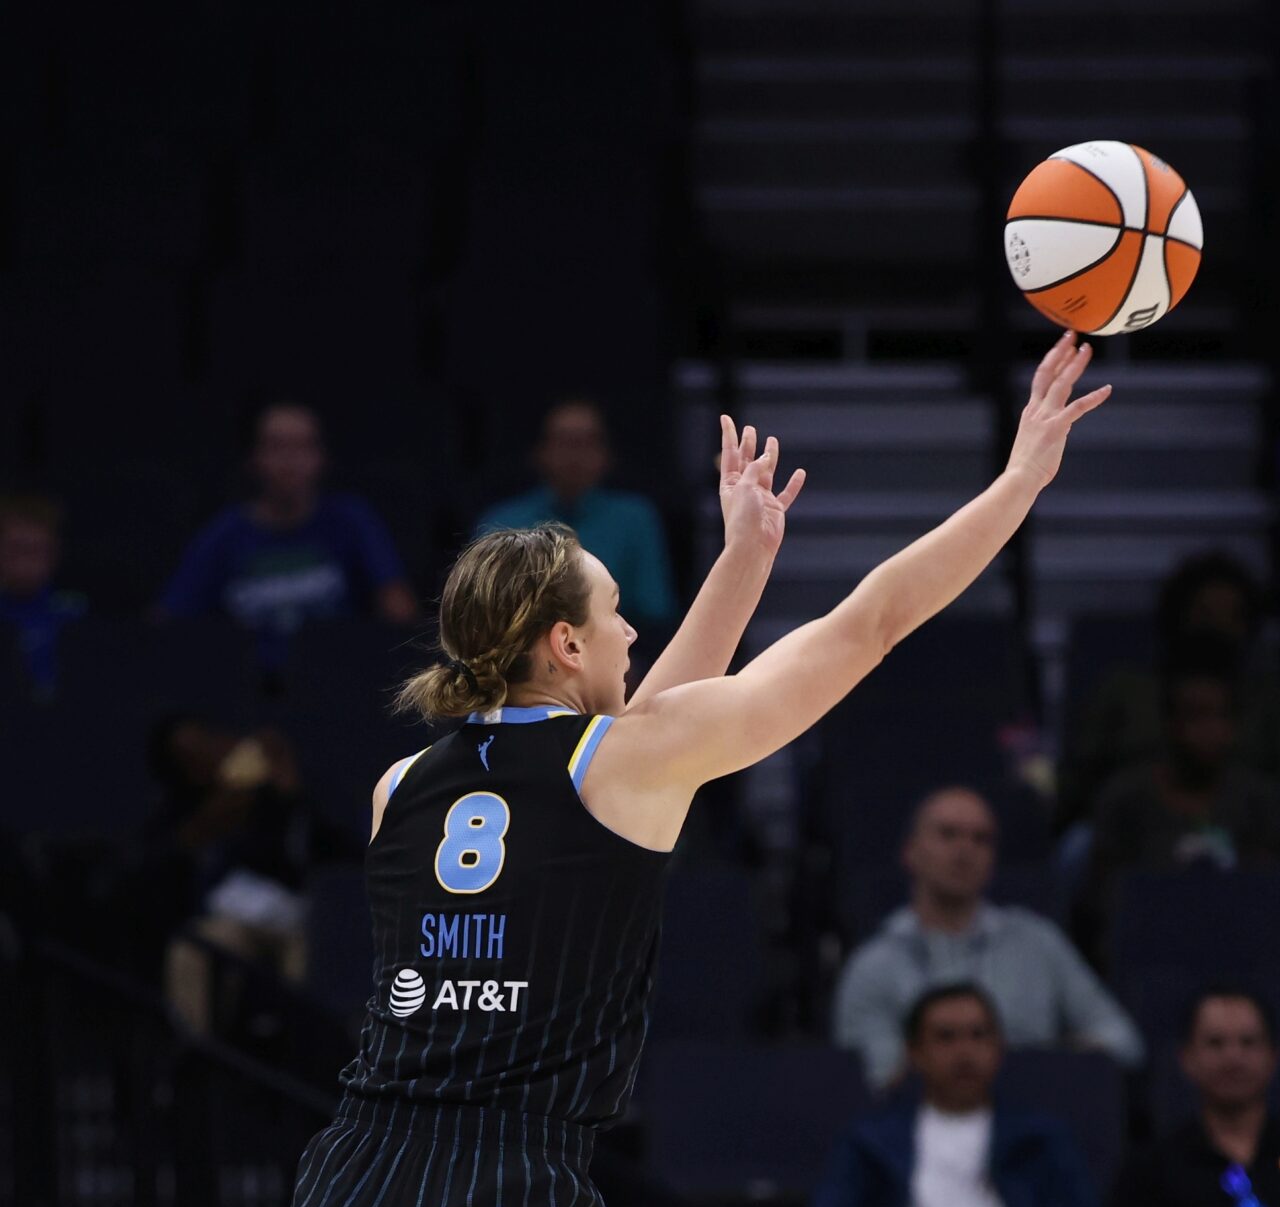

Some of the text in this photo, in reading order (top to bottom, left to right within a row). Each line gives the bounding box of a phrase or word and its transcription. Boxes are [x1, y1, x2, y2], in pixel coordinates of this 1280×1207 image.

[434, 791, 511, 894] 8
[420, 914, 507, 959] SMITH
[432, 979, 529, 1012] AT&T
